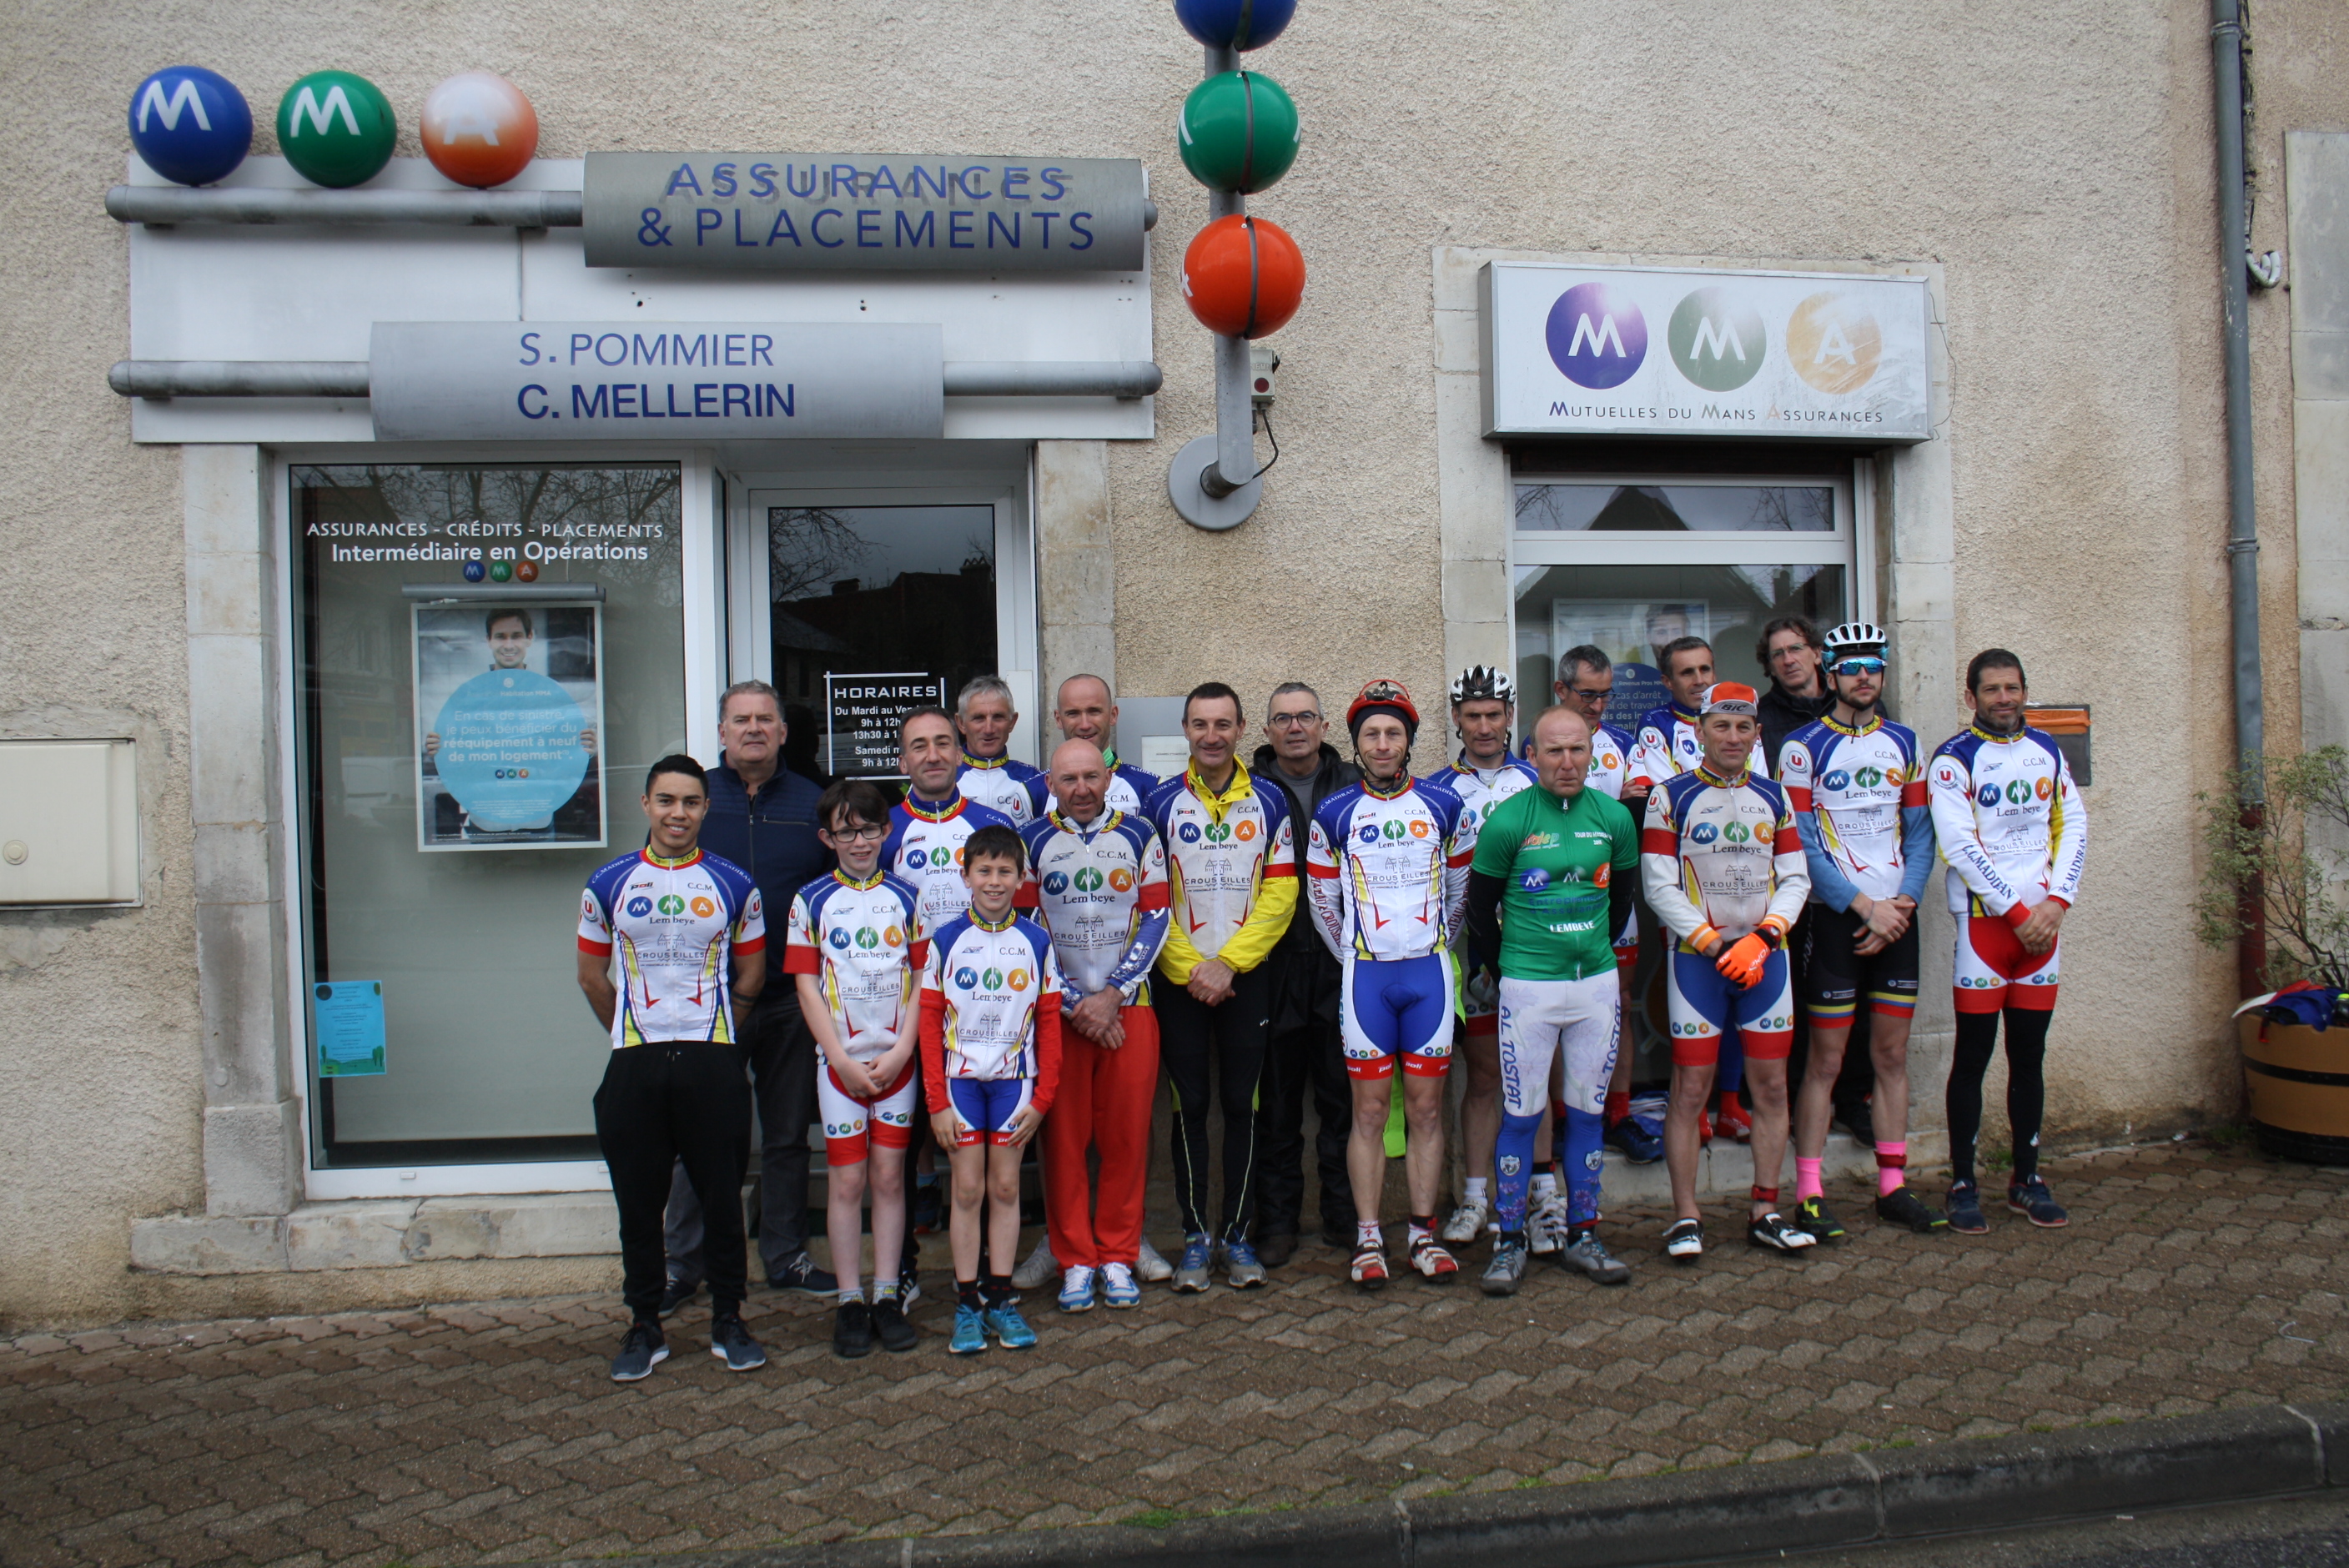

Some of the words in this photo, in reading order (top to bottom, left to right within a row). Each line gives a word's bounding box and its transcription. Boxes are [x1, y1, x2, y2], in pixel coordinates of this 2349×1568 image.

[667, 162, 1067, 202] ASSURANCES
[637, 207, 672, 247] &
[697, 209, 1094, 251] PLACEMENTS
[1549, 400, 1657, 420] MUTUELLES
[1668, 406, 1693, 420] DU
[1701, 403, 1757, 421] MANS
[1767, 405, 1884, 424] ASSURANCES
[306, 522, 429, 538] ASSURANCES
[446, 520, 523, 538] CRÉDITS
[541, 523, 664, 540] PLACEMENTS
[332, 541, 483, 563] Intermédiaire
[490, 547, 517, 560] en
[524, 540, 649, 565] Opérations
[834, 686, 937, 698] HORAIRES
[835, 707, 848, 716] Du
[852, 706, 878, 715] Mardi
[1720, 704, 1748, 712] BIC
[455, 711, 470, 721] En
[475, 712, 495, 721] cas
[499, 711, 515, 721] de
[861, 718, 873, 727] 9h
[875, 718, 881, 726] à
[446, 726, 457, 736] je
[460, 726, 491, 736] peux
[561, 722, 577, 733] du
[853, 731, 881, 739] 13h30
[884, 730, 890, 739] à
[444, 737, 533, 749] rééquipement
[537, 736, 545, 746] à
[549, 736, 577, 746] neuf
[448, 751, 465, 761] de
[469, 753, 497, 761] mon
[855, 746, 890, 755] Samedi
[862, 758, 874, 766] 9h
[877, 757, 883, 766] à
[1096, 850, 1127, 860] C.C.M
[1550, 920, 1595, 932] LEMBEYE
[1602, 1000, 1622, 1073] TOSTAT
[1502, 1039, 1522, 1110] TOSTAT
